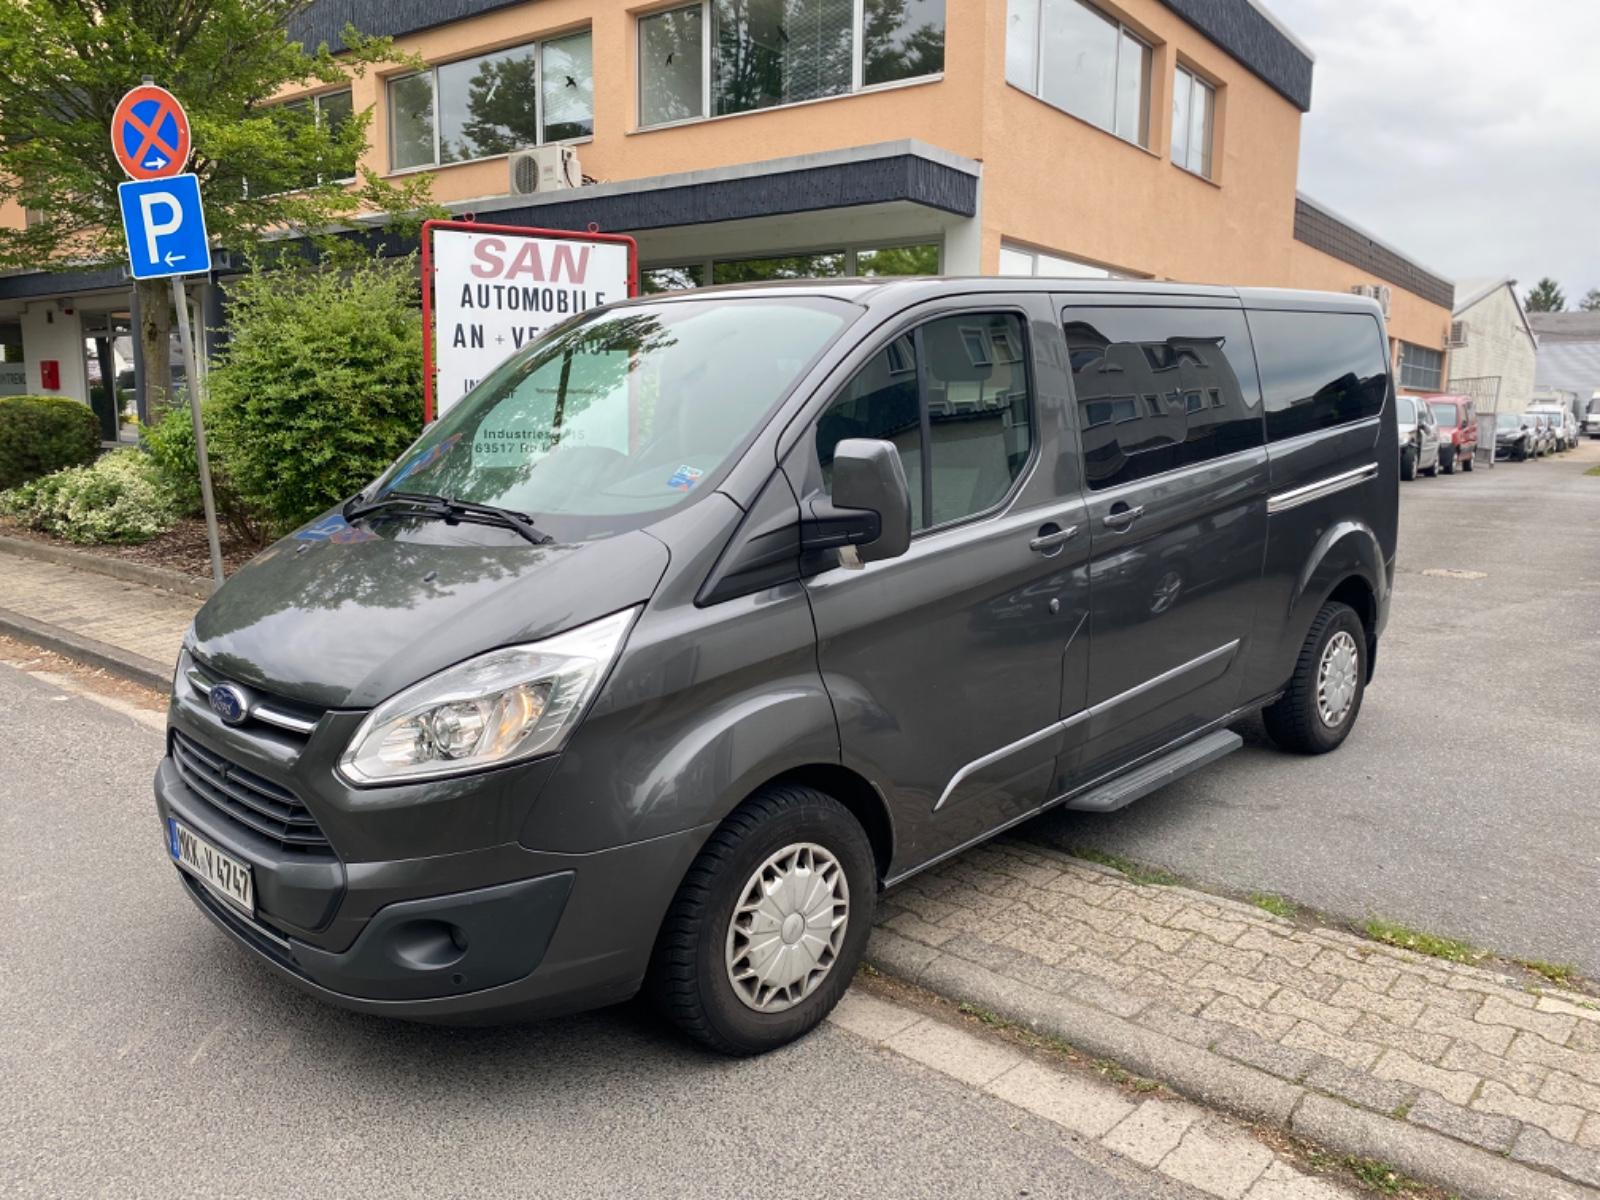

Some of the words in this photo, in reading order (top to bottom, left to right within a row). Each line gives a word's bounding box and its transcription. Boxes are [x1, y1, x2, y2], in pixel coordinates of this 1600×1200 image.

[139, 191, 183, 264] P
[470, 238, 590, 284] SAN
[460, 283, 606, 314] AUTOMOBILE
[453, 323, 484, 348] AN
[475, 443, 515, 454] 63517
[216, 855, 249, 902] 4747
